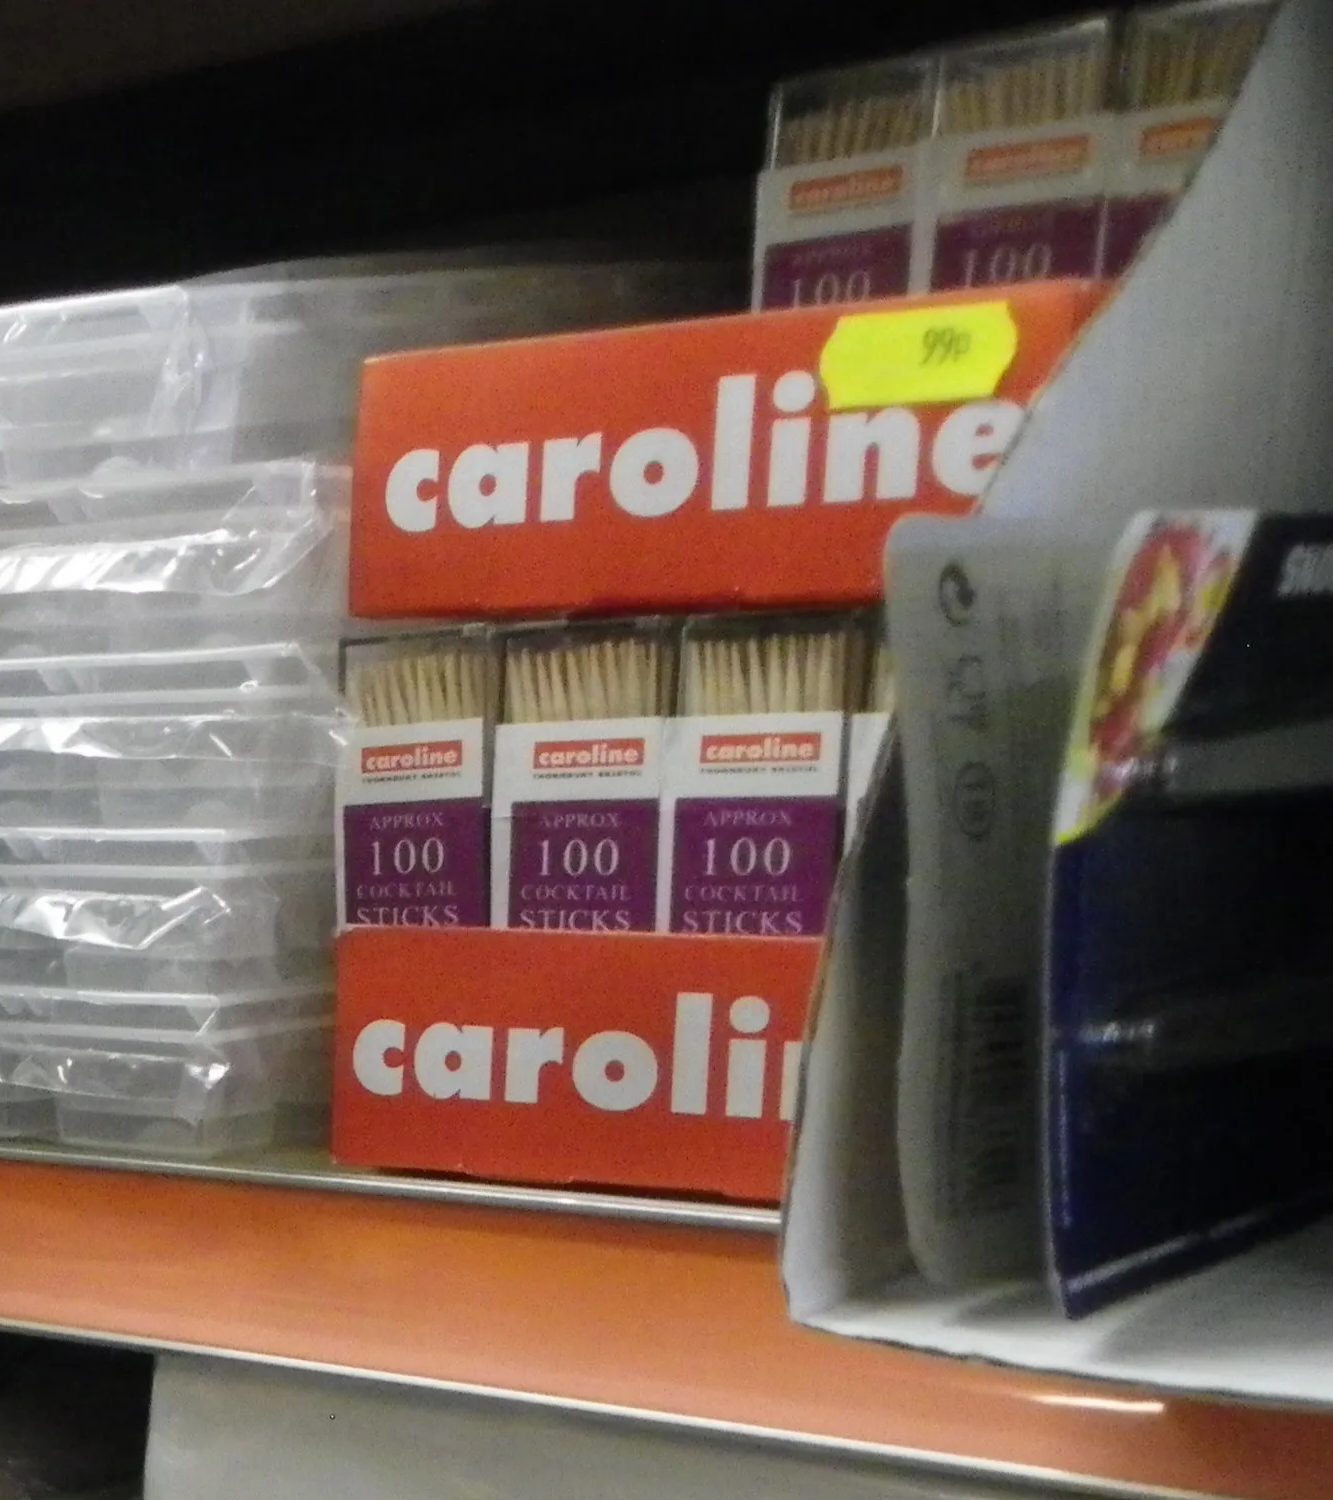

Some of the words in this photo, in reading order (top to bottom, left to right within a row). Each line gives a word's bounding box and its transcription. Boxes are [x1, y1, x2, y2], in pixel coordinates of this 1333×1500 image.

[921, 327, 972, 364] 99p
[385, 371, 1025, 533] caroline
[366, 744, 459, 771] caroline
[538, 742, 639, 768] caroline
[704, 735, 815, 762] caroline
[369, 812, 444, 830] APPROX
[538, 811, 621, 829] APPROX
[704, 809, 792, 827] APPROX
[371, 838, 445, 876] 100
[539, 838, 620, 876] 100
[703, 837, 791, 876] 100
[357, 878, 457, 900] COCKTAIL
[520, 882, 630, 902] COCKTAIL
[685, 882, 803, 902] COCKTAIL
[356, 904, 460, 929] STICKS
[520, 909, 630, 932] STICKS
[683, 910, 803, 935] STICKS
